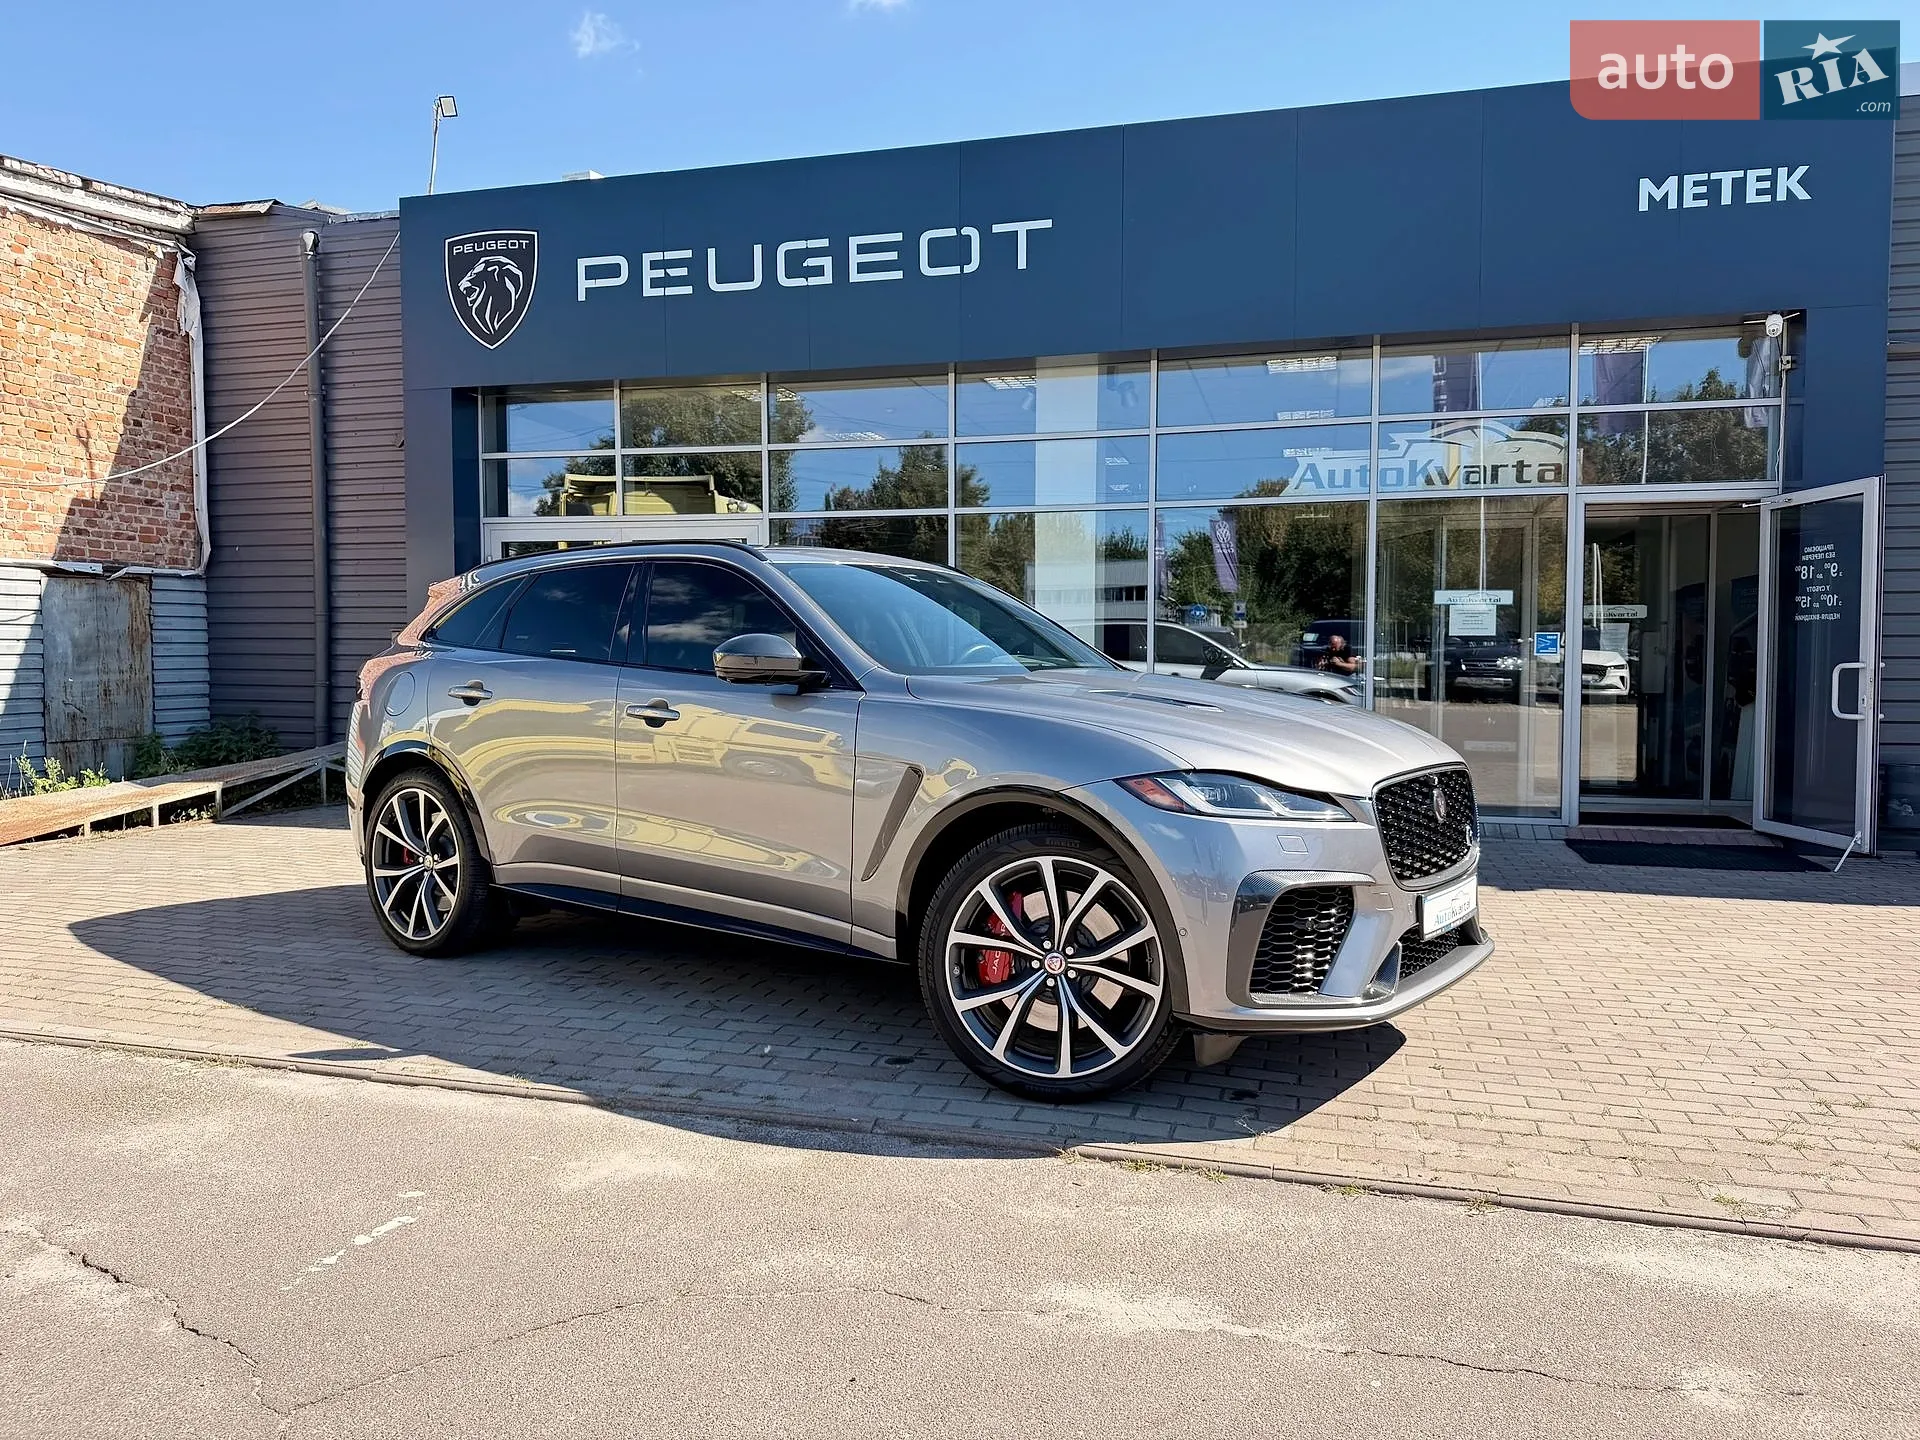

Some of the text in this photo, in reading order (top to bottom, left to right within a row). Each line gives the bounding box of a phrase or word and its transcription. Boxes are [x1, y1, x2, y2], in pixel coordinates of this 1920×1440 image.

[1638, 165, 1812, 212] METEK
[453, 240, 529, 256] PEUGEOT
[577, 219, 1053, 302] PEUGEOT
[1293, 458, 1568, 490] AutoKvarta
